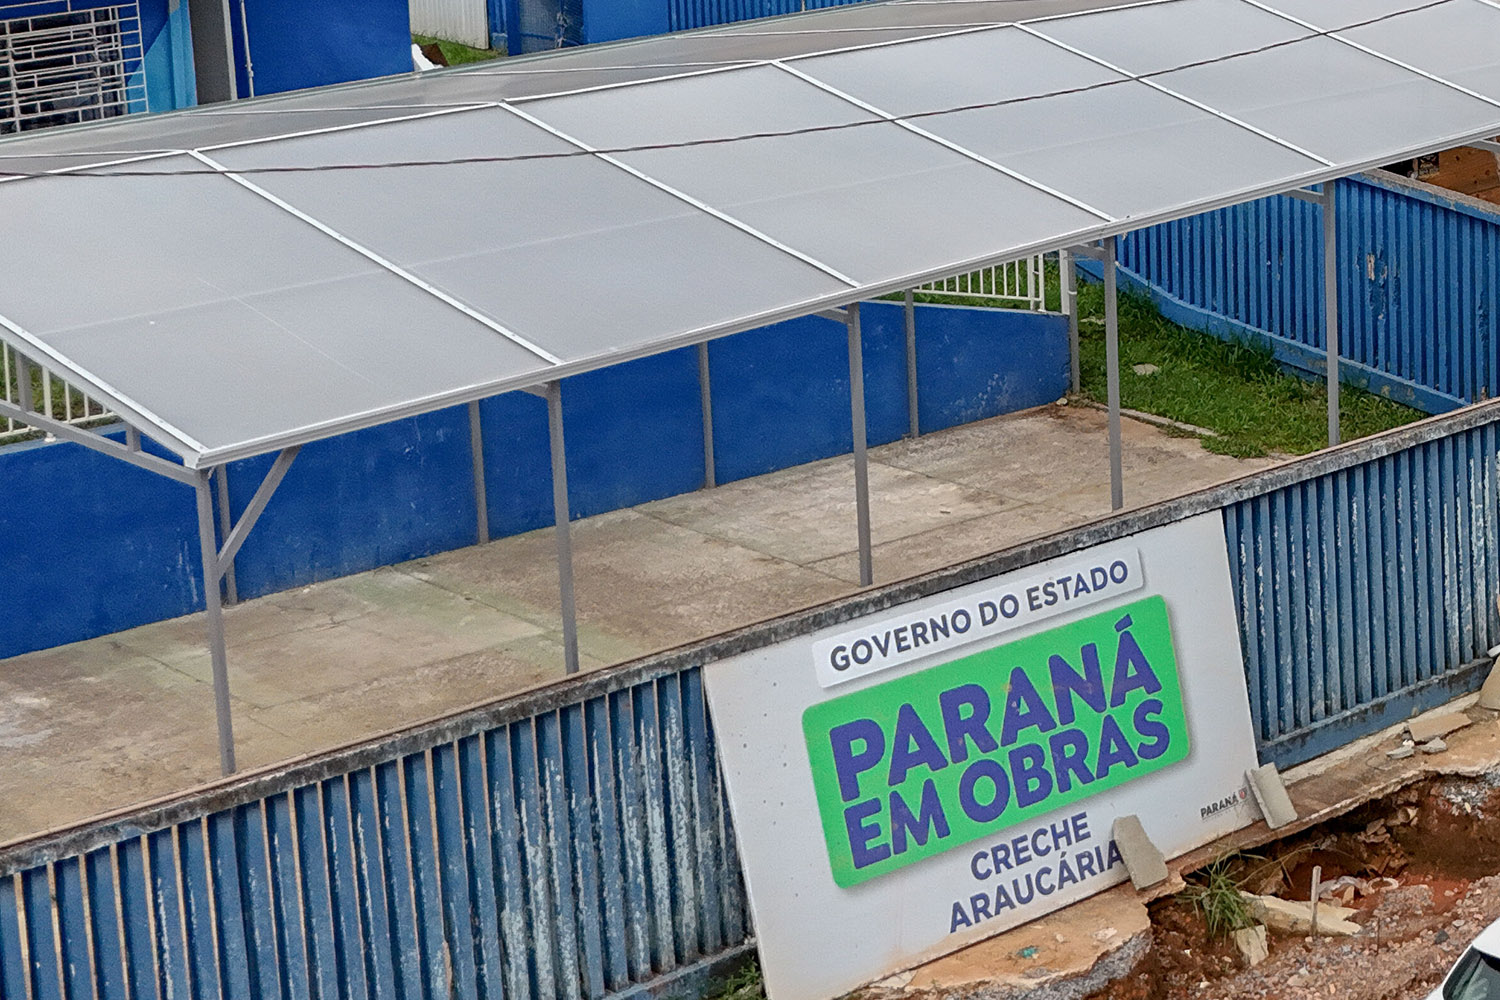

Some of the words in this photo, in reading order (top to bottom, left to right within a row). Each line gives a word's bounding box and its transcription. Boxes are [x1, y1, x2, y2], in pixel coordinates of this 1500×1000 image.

[830, 609, 972, 671] GOVERNO
[979, 594, 1020, 626] DO
[1026, 560, 1128, 612] ESTADO
[829, 613, 1162, 802] PARANÁ
[843, 778, 951, 869] EM
[958, 698, 1170, 823] OBRAS
[1200, 791, 1239, 818] PARANÁ
[950, 839, 1126, 934] ARAUCÁRIA
[970, 811, 1091, 880] CRECHE
